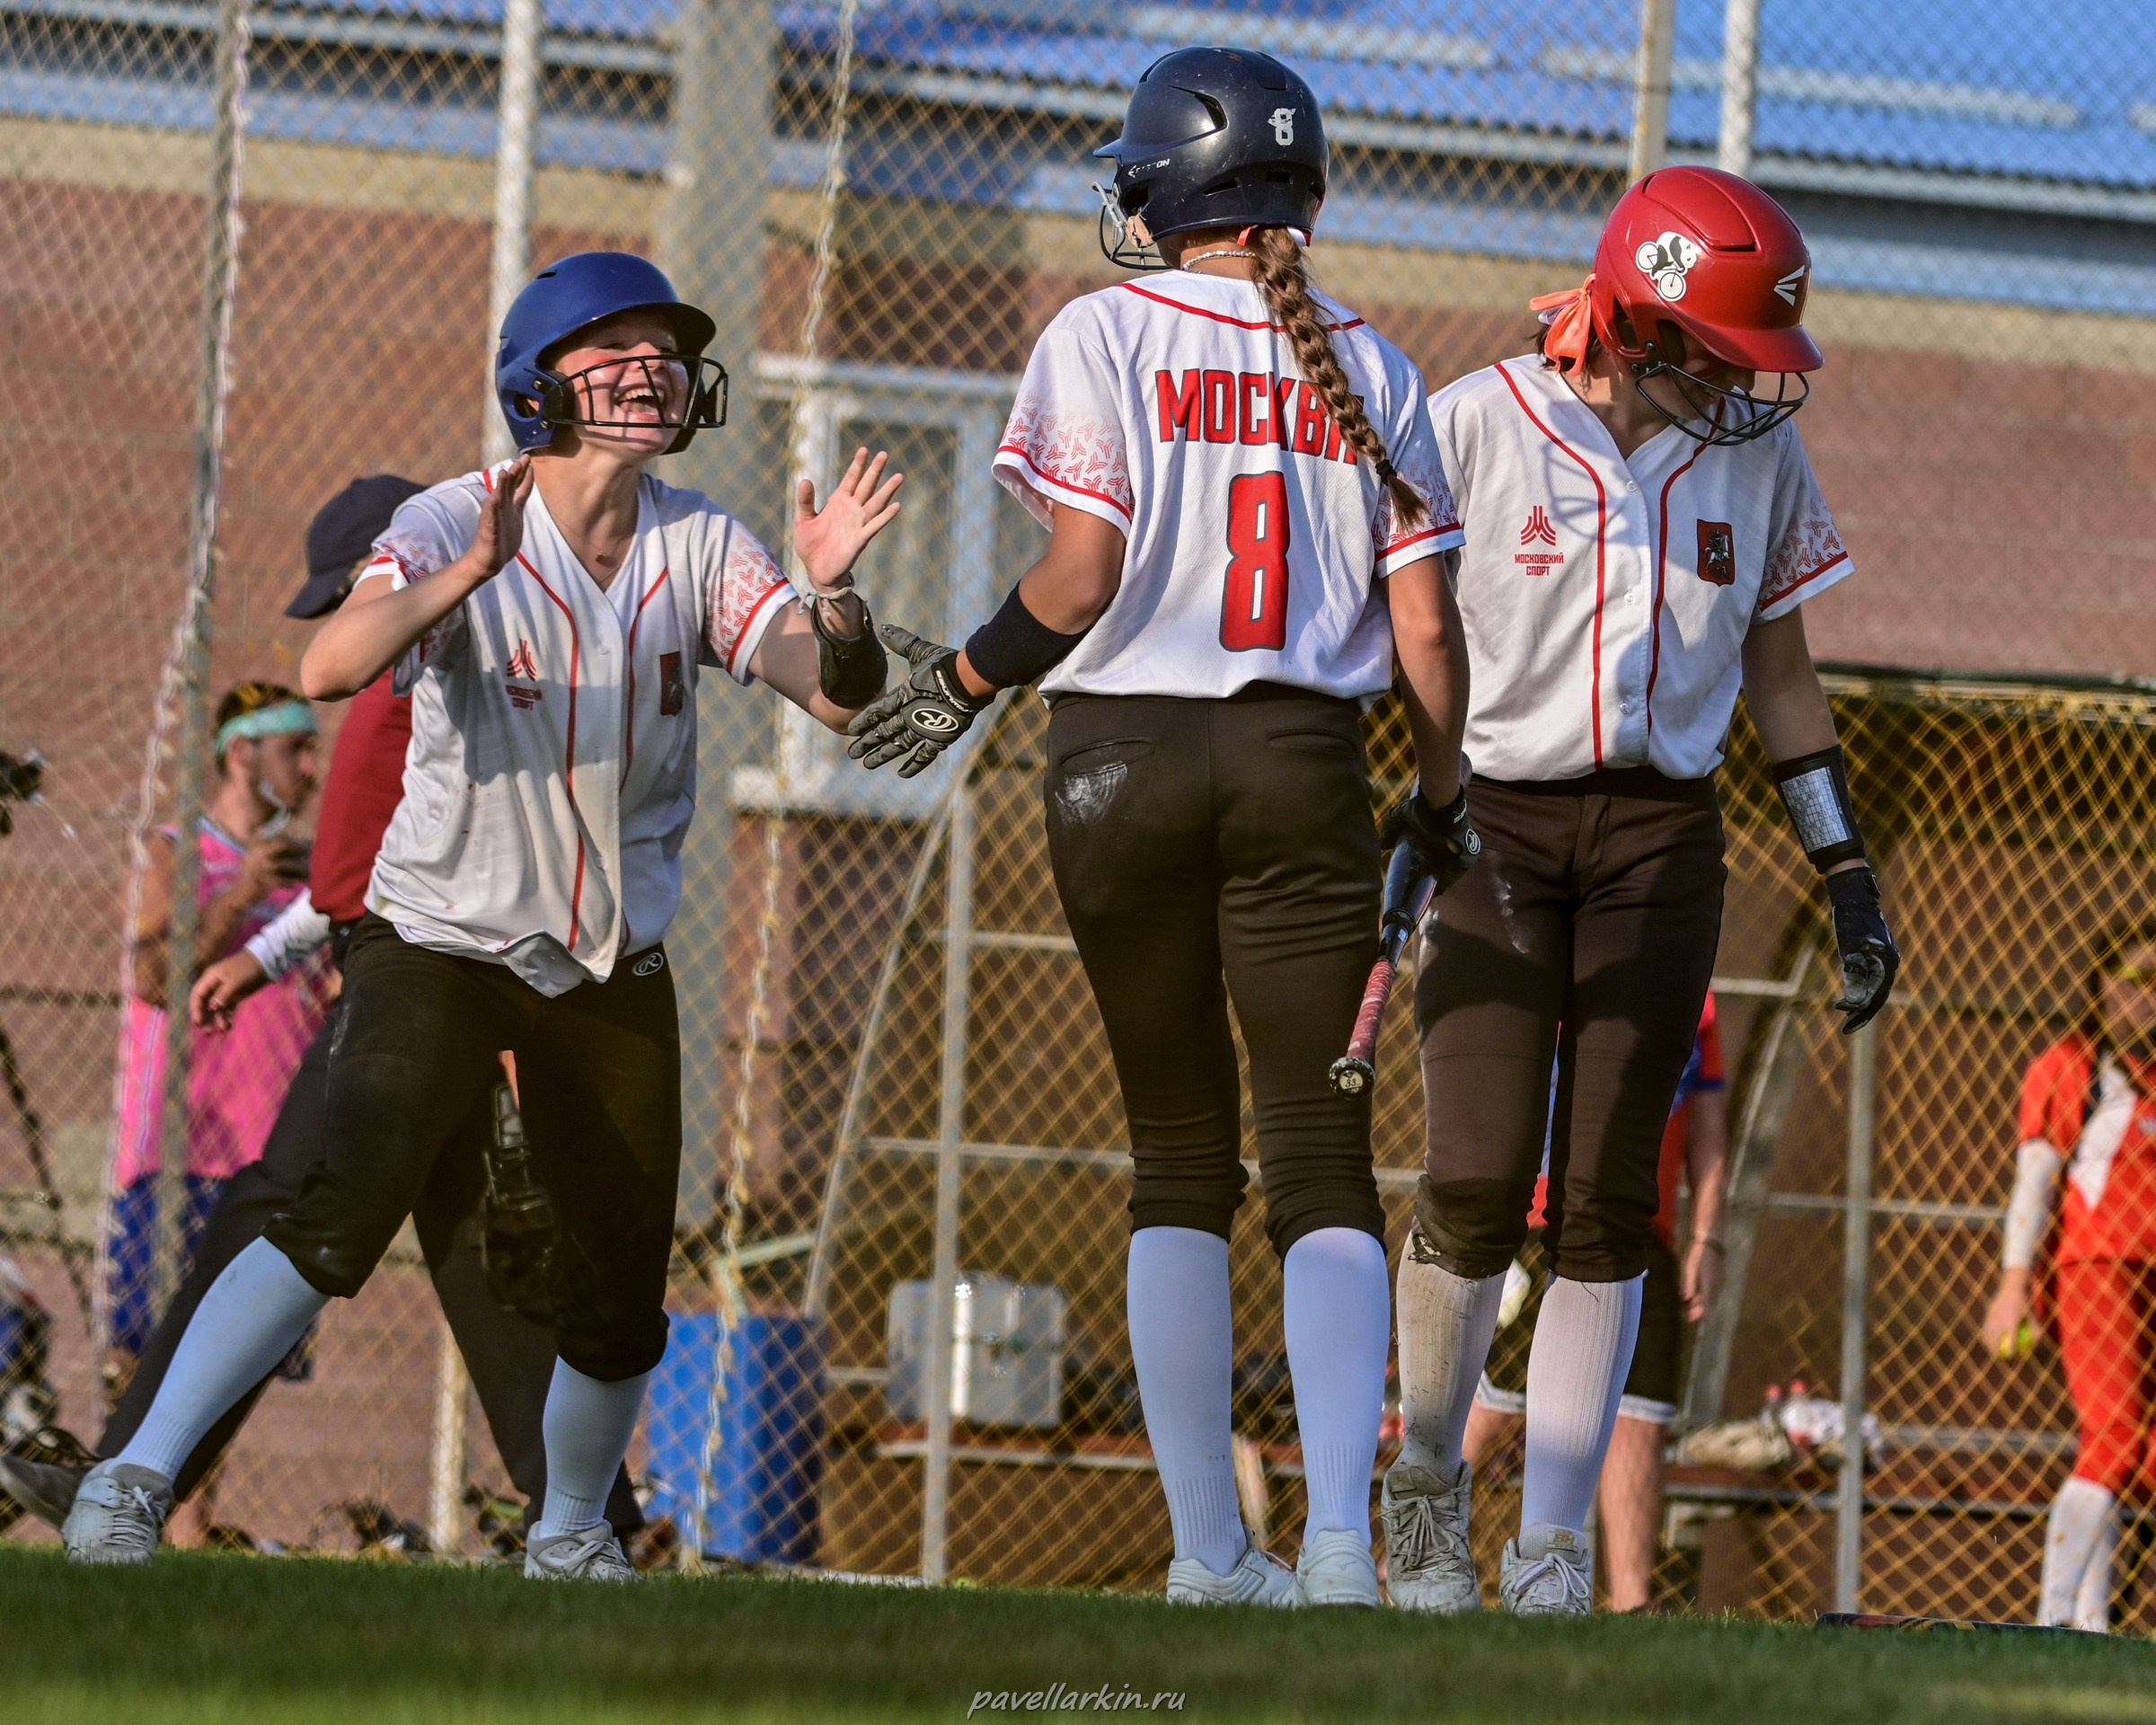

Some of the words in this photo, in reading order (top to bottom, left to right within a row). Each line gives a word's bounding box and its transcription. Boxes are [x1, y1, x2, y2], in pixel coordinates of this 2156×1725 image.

[1272, 107, 1295, 146] 8
[1219, 471, 1291, 652] 8
[1515, 552, 1564, 564] МОСКОВСКИЙ
[1526, 565, 1551, 576] СПОРТ
